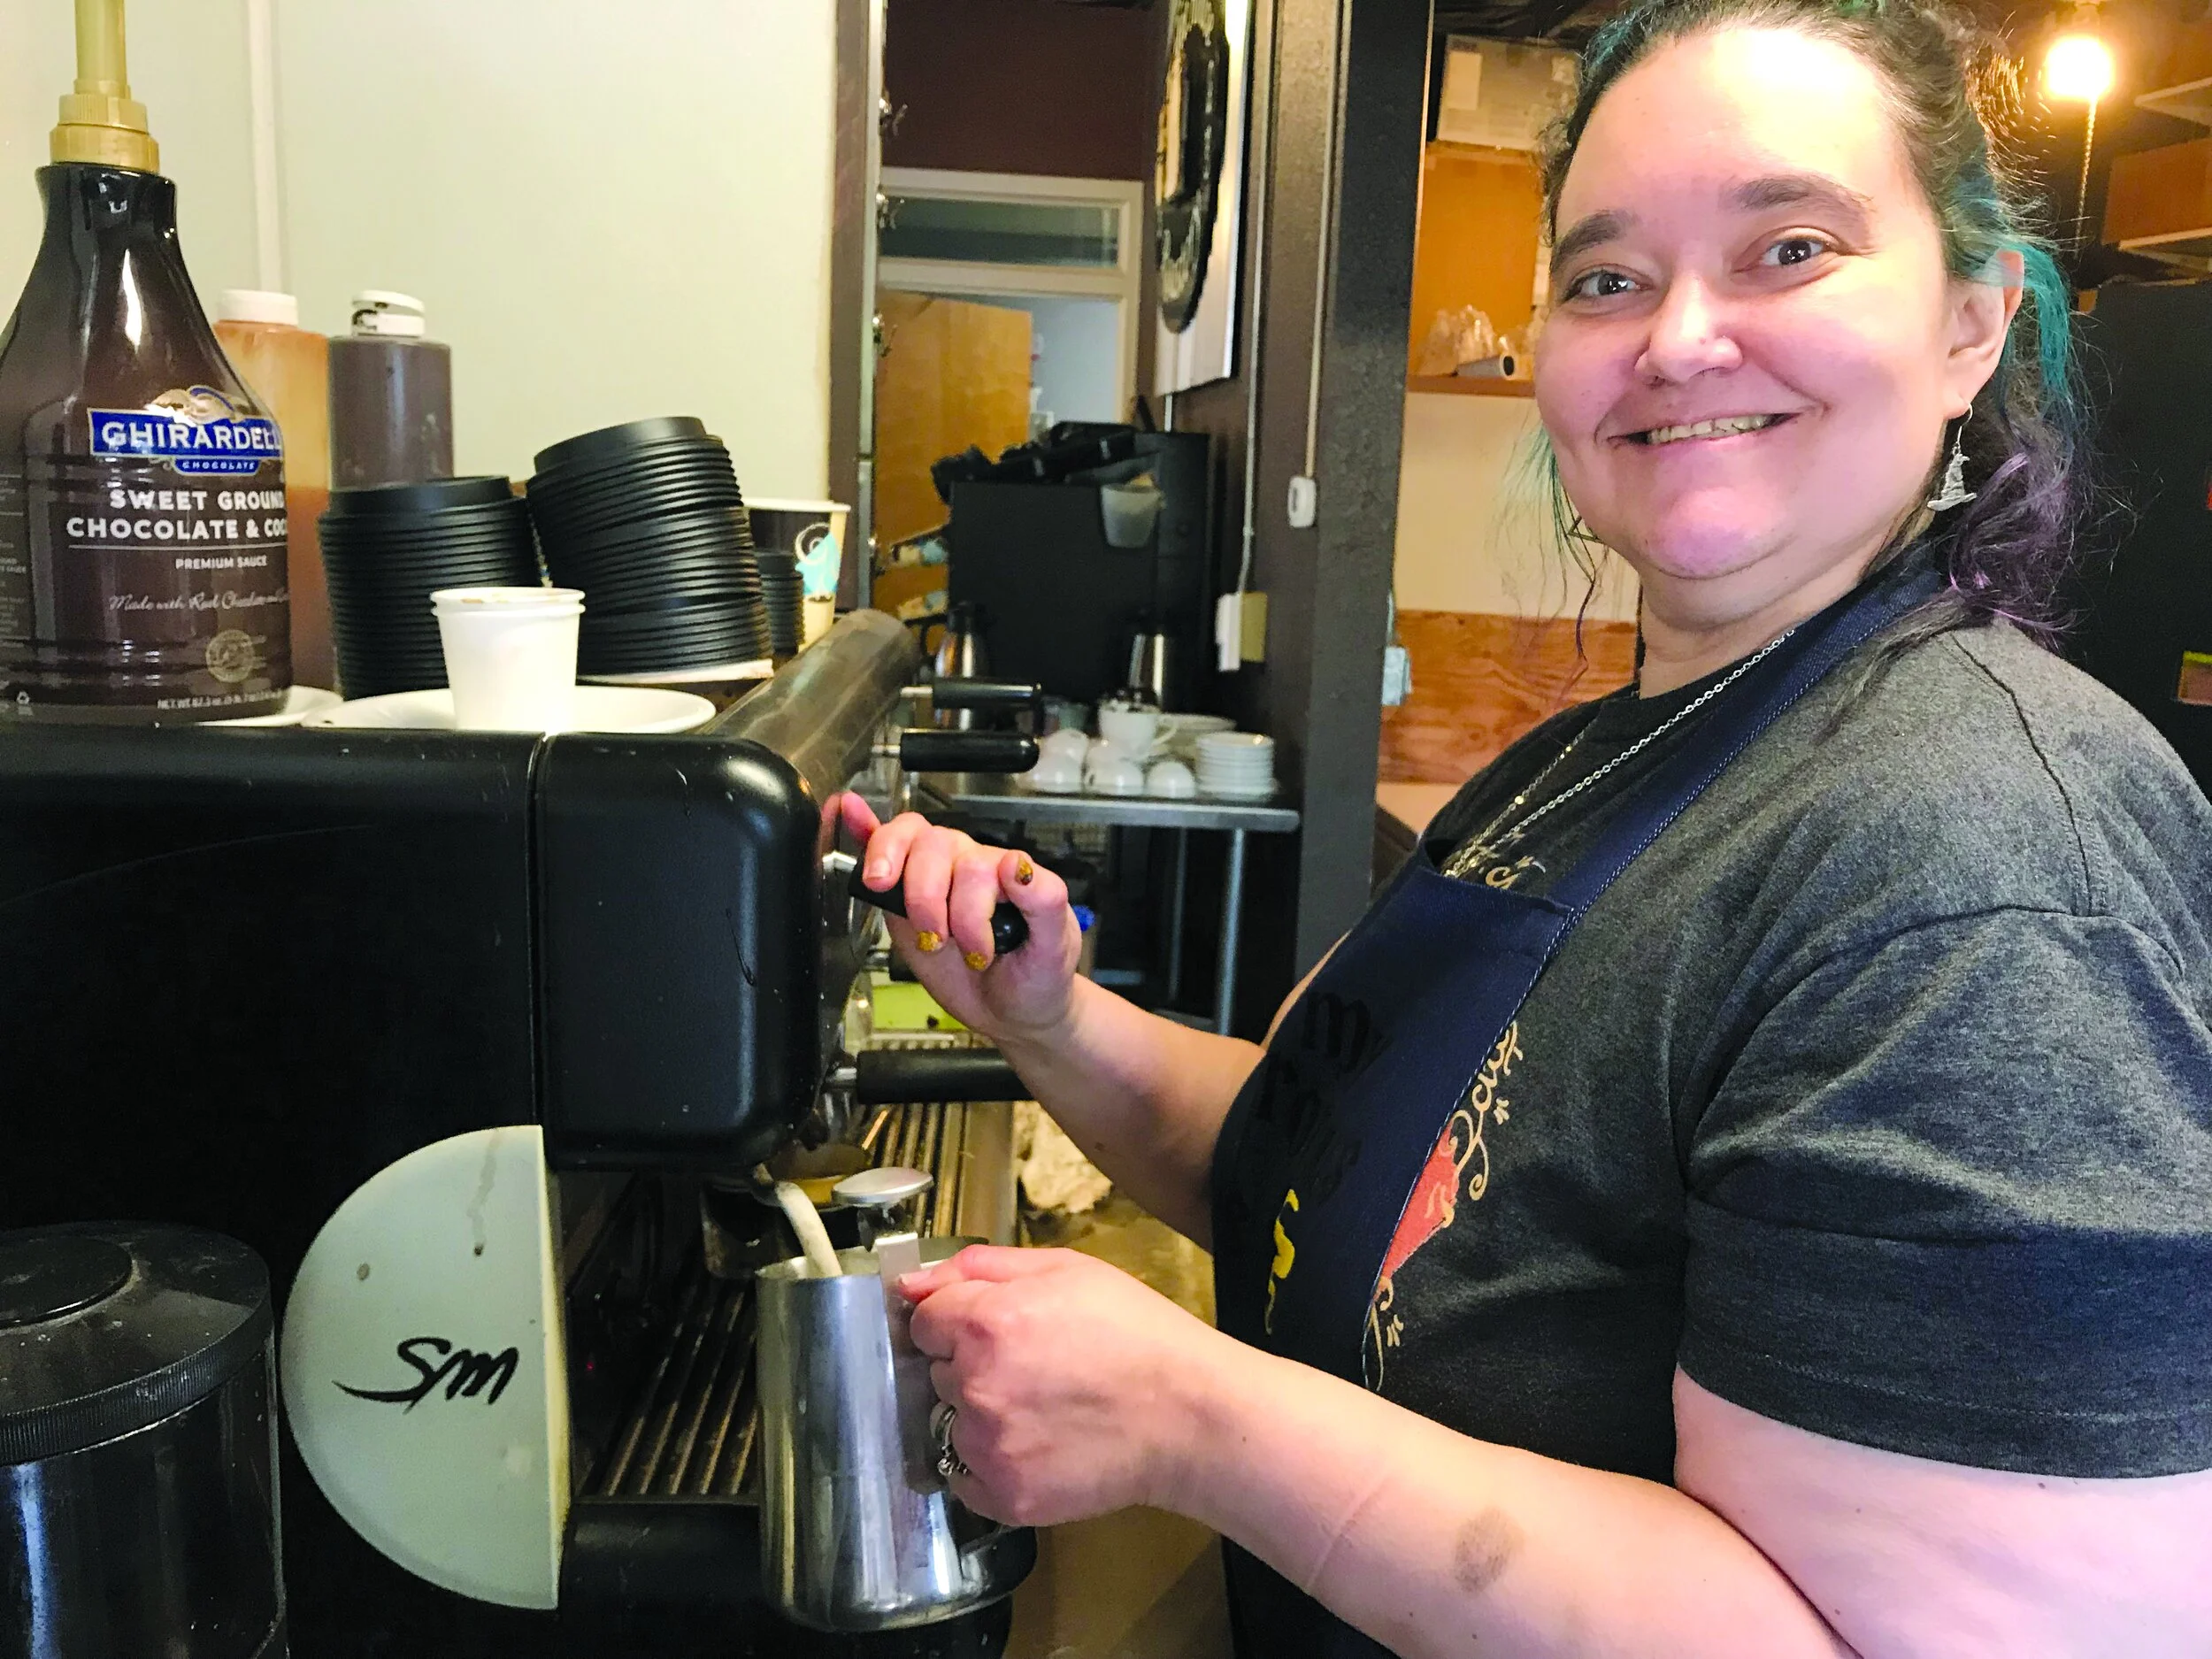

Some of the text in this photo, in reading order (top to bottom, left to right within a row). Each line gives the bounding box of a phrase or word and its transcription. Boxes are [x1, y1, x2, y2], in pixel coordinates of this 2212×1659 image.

[101, 420, 282, 450] GHIRARDELL
[181, 461, 256, 471] CHOCOLATE
[109, 489, 208, 511] SWEET
[66, 517, 288, 541] CHOCOLATE & COC
[175, 555, 267, 570] PREMIUM SAUCE
